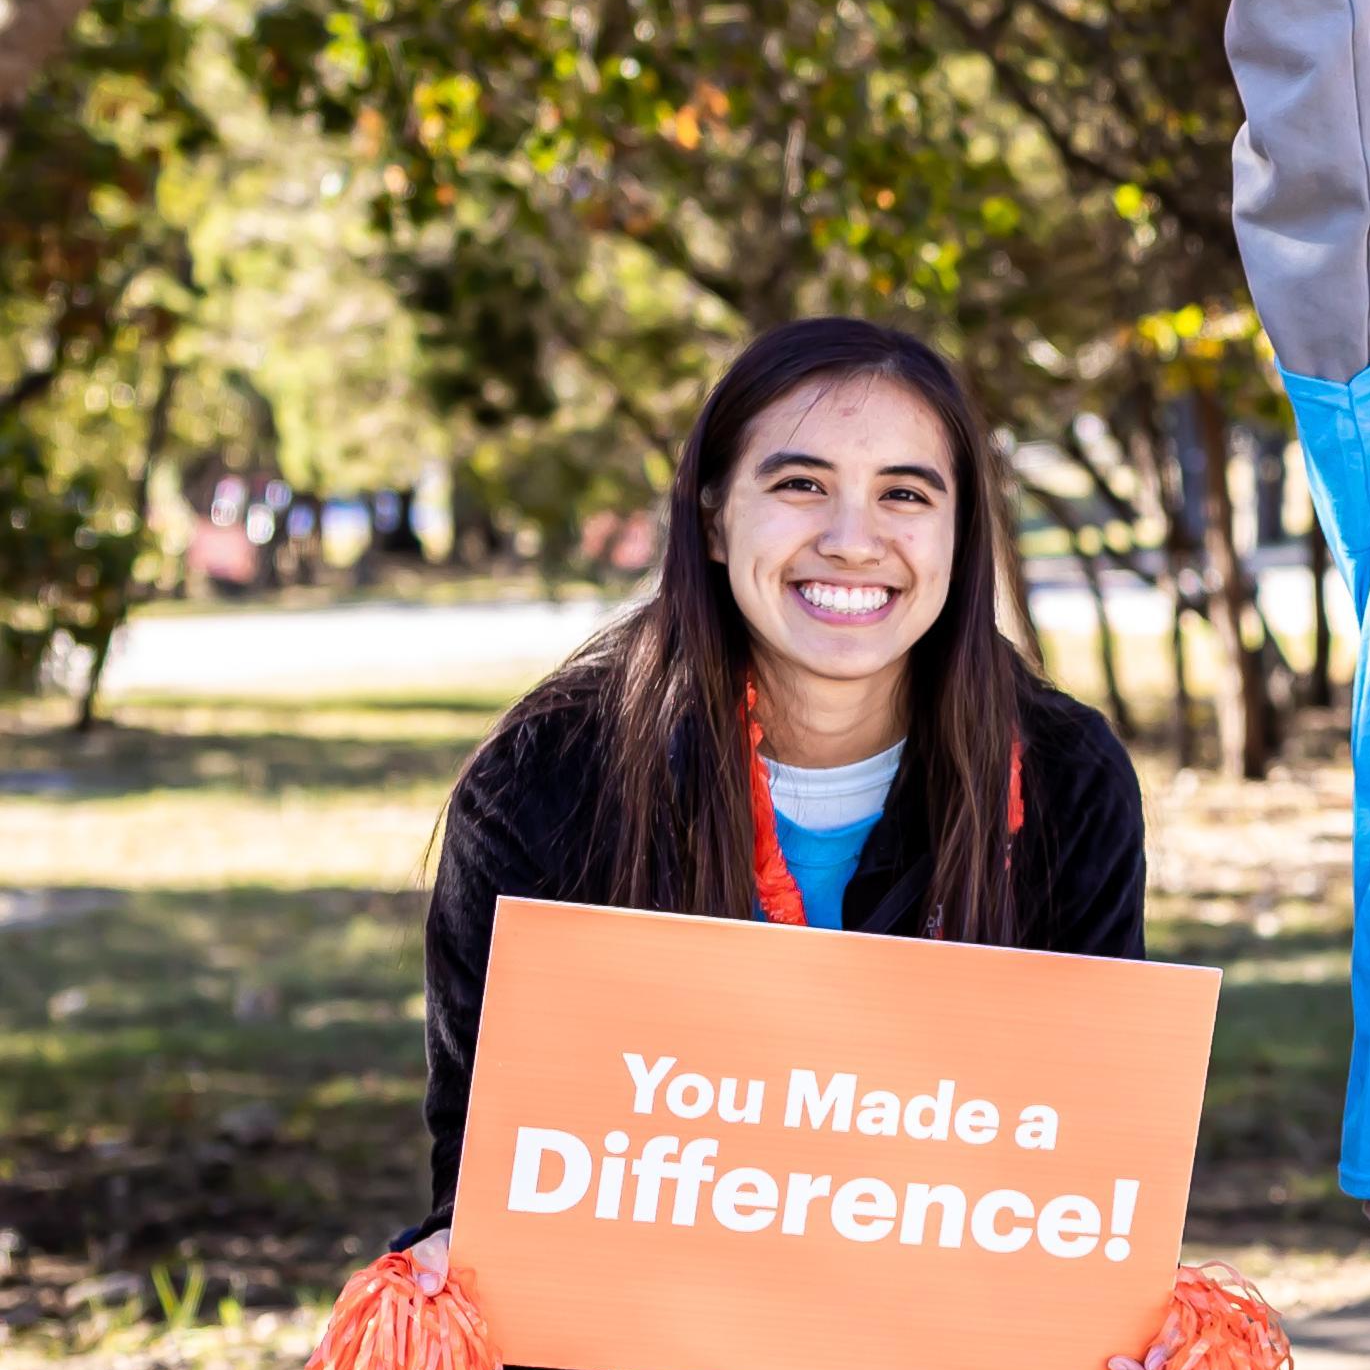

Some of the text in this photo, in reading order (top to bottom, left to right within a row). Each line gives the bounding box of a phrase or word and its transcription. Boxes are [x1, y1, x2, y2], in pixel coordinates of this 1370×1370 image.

[624, 1053, 1059, 1150] You Made a
[508, 1127, 1140, 1262] Difference!
